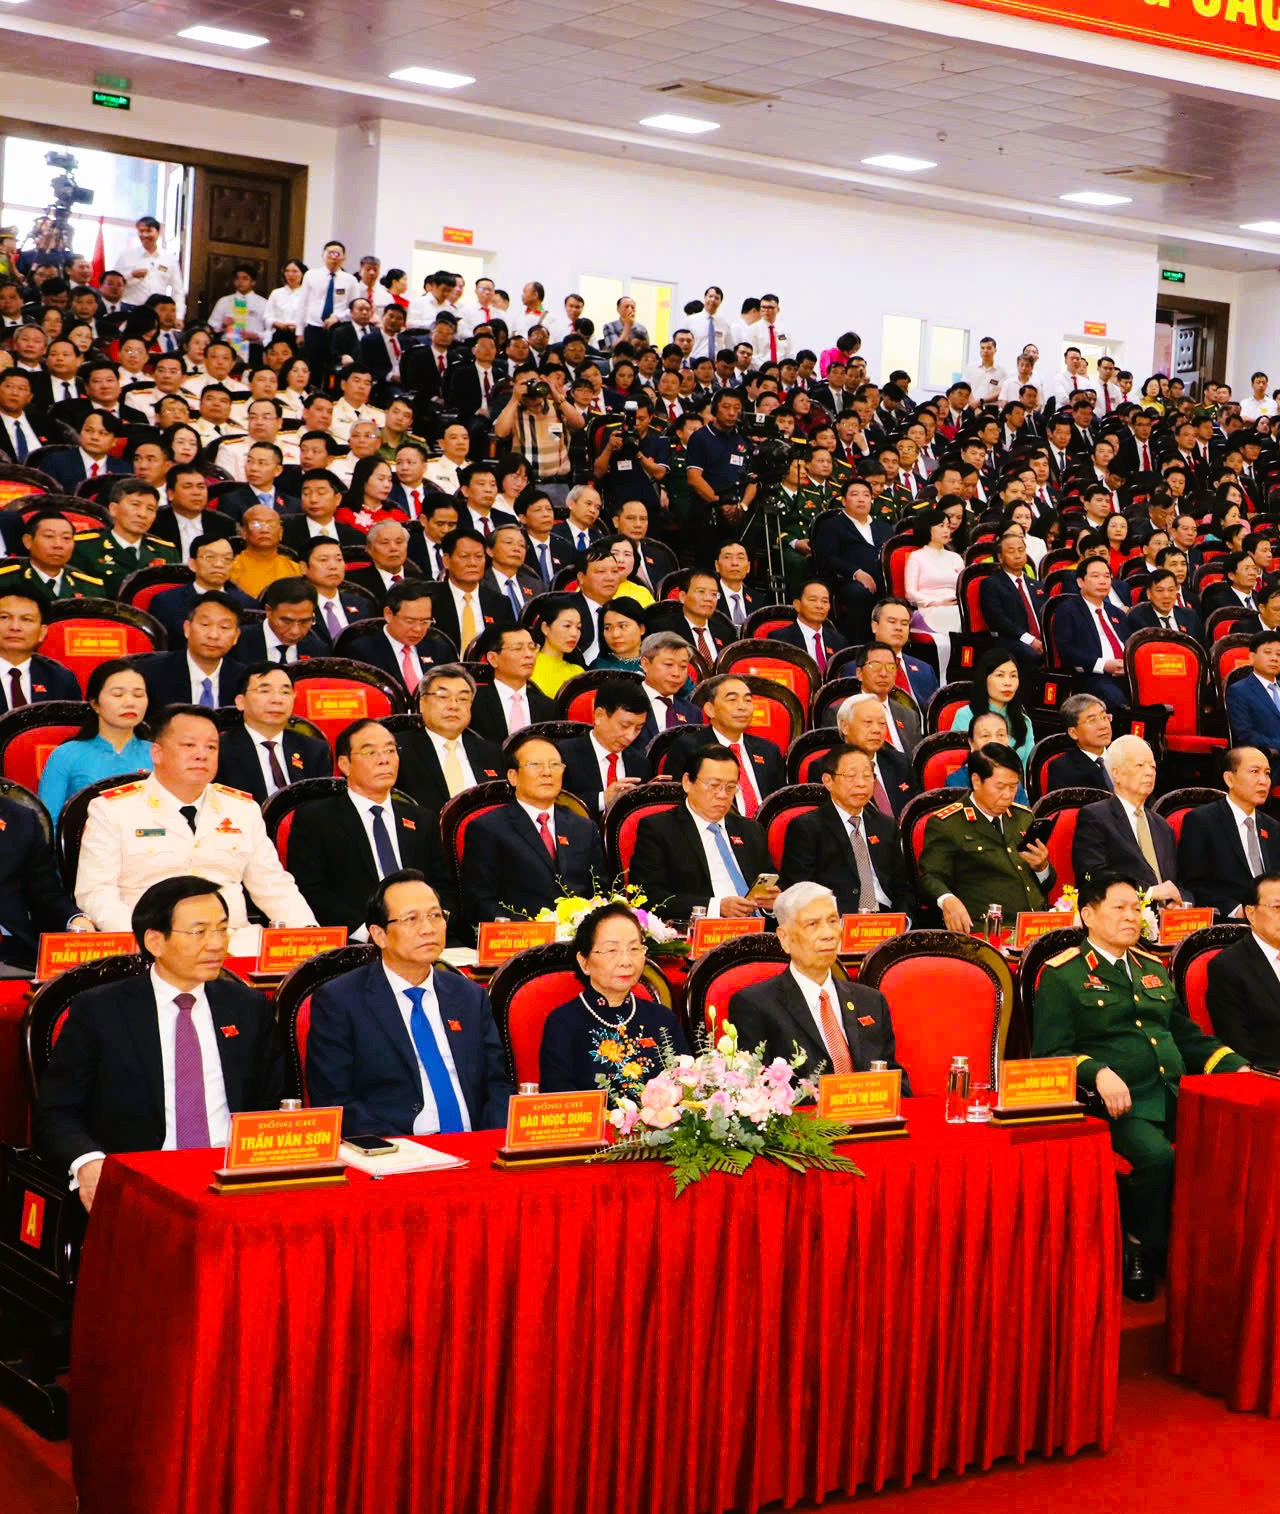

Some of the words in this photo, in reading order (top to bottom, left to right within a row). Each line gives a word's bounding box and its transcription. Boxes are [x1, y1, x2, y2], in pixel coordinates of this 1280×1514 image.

[51, 948, 78, 963] TRẦN
[830, 1090, 857, 1106] NGUYỄN
[541, 1112, 566, 1129] NGỌC
[240, 1132, 274, 1151] TRẦN
[277, 1132, 302, 1147] VĂN
[305, 1131, 332, 1145] SƠN
[26, 1202, 37, 1237] A
